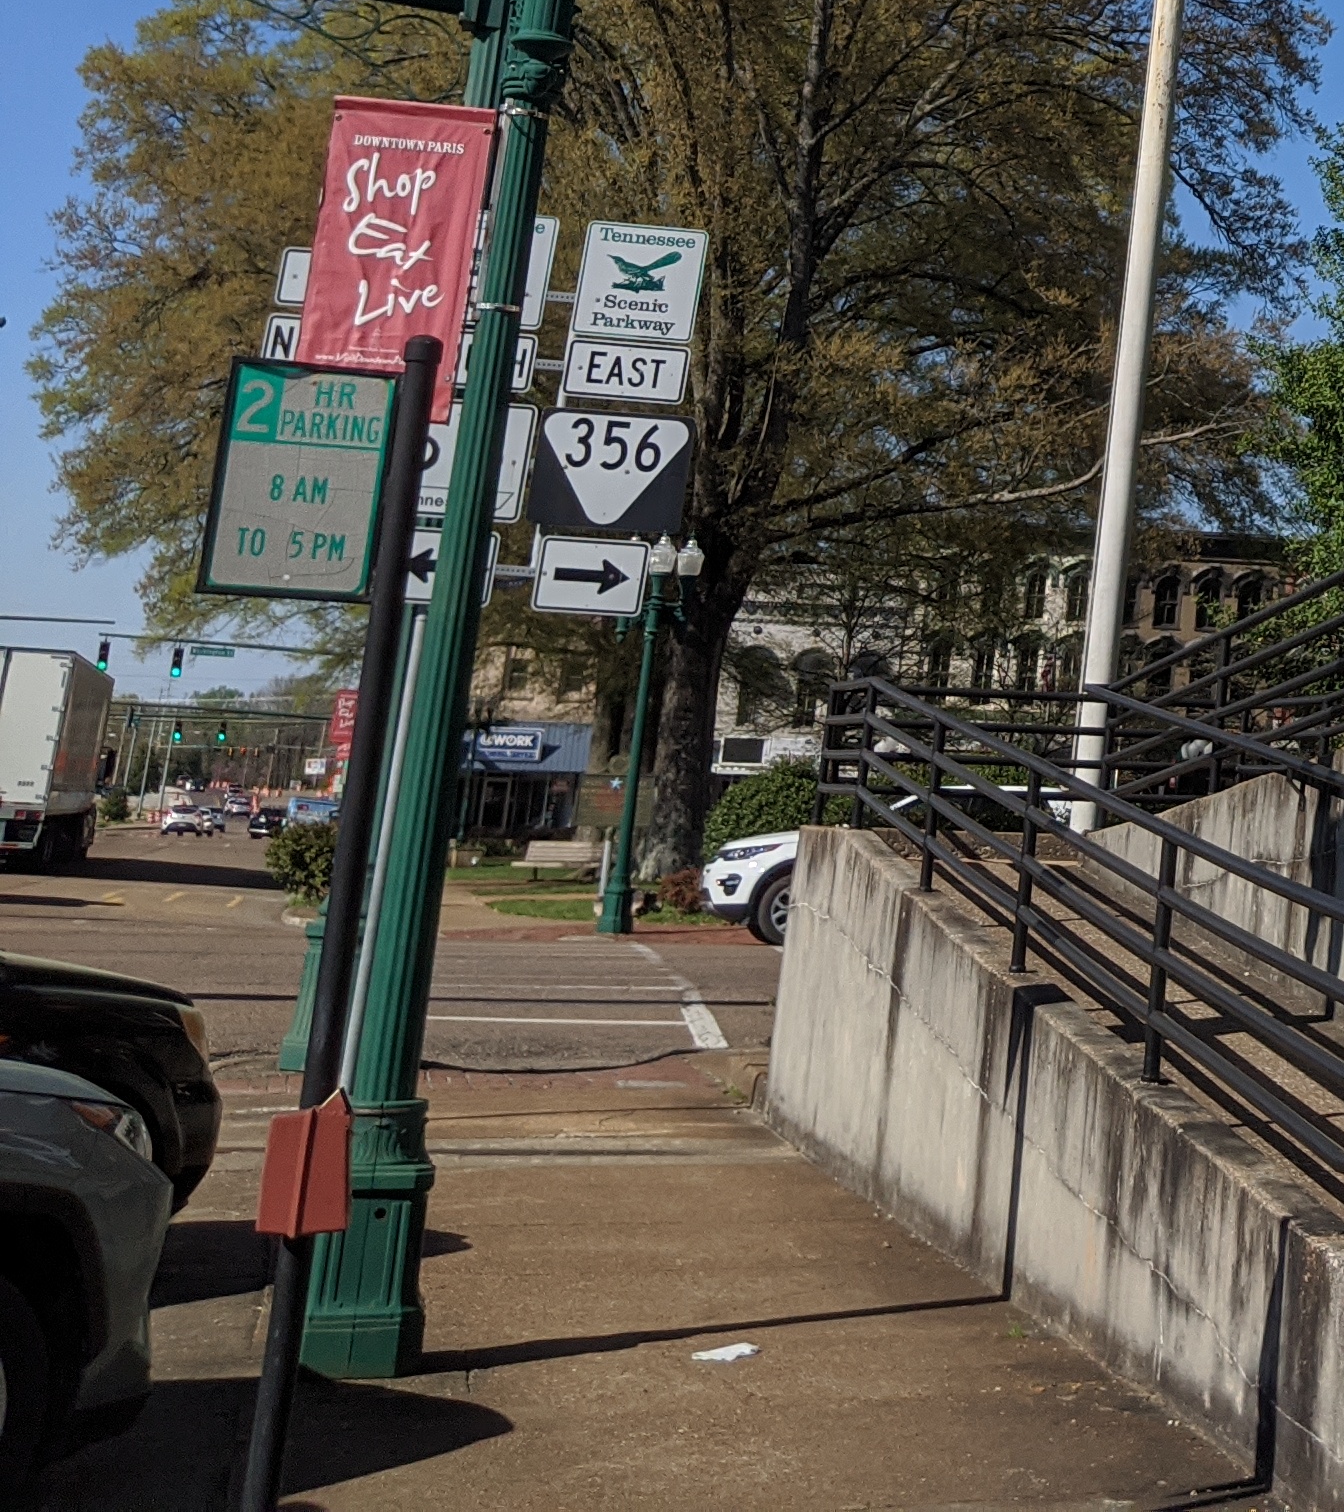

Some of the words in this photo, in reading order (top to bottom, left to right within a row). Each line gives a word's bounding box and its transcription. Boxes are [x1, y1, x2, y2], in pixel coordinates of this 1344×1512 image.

[354, 134, 425, 151] DOWNTOWN
[427, 141, 465, 155] PARIS
[343, 152, 436, 215] Shop
[348, 213, 433, 270] Eat
[600, 227, 696, 249] Tennessee
[354, 278, 445, 326] Live
[603, 294, 669, 314] Scenic
[590, 312, 676, 336] Parkway
[586, 351, 667, 389] EAST
[236, 379, 274, 433] 2
[315, 380, 357, 410] HR
[279, 409, 381, 444] PARKING
[565, 417, 662, 473] 356
[270, 474, 284, 501] 8
[292, 476, 329, 505] AM
[238, 527, 266, 557] TO
[289, 531, 304, 559] 5
[311, 532, 346, 562] PM
